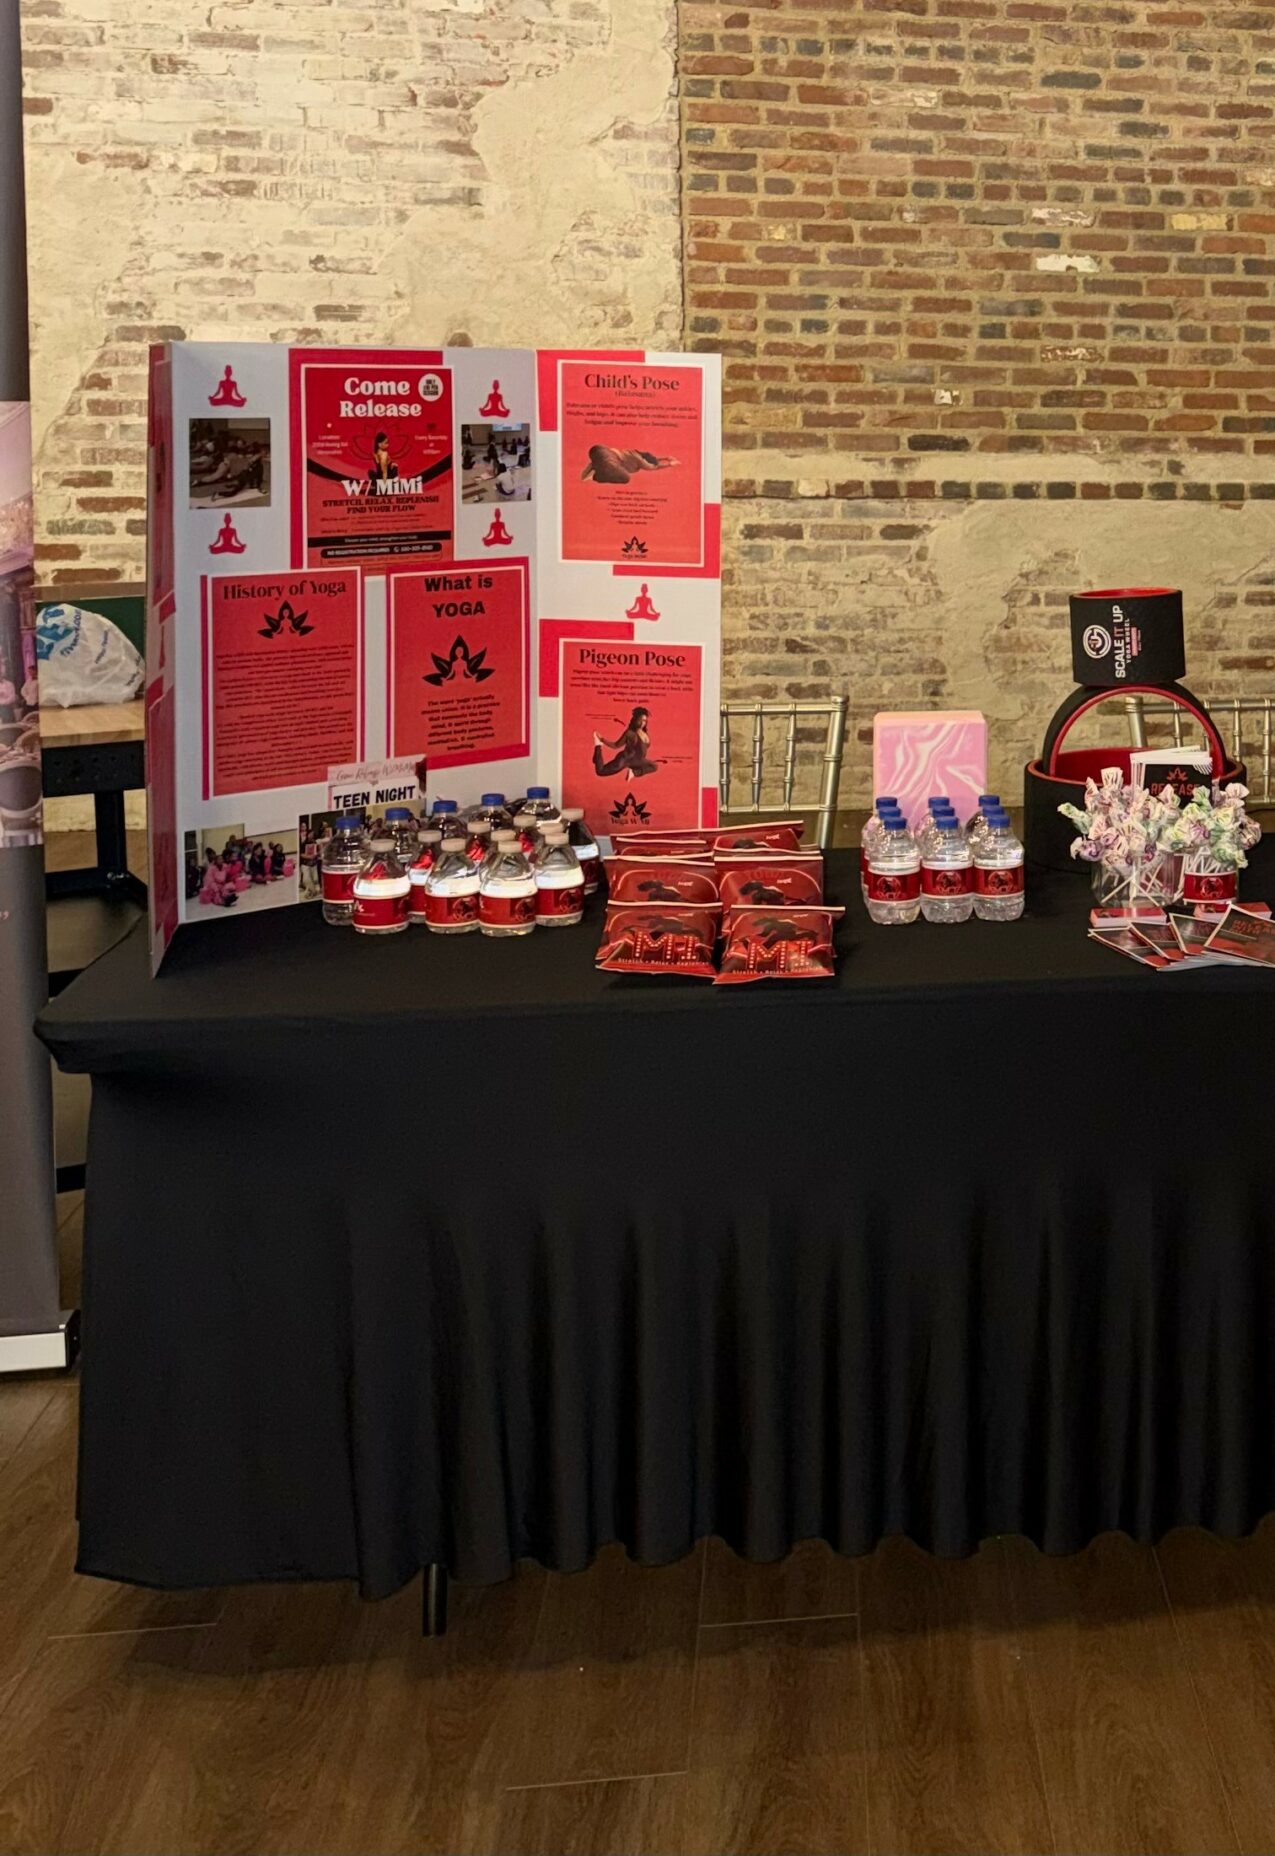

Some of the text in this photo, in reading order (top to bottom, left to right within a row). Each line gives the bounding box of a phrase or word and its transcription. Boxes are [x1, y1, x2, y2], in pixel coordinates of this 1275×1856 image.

[343, 377, 411, 396] Come
[584, 373, 680, 391] Child's Pose
[339, 399, 422, 417] Release
[223, 580, 346, 600] History of Yoga
[424, 574, 493, 592] What is
[432, 600, 486, 618] YOGA
[1112, 604, 1127, 678] SCALE IT UP
[579, 648, 686, 668] Pigeon Pose
[333, 785, 416, 809] TEEN NIGHT
